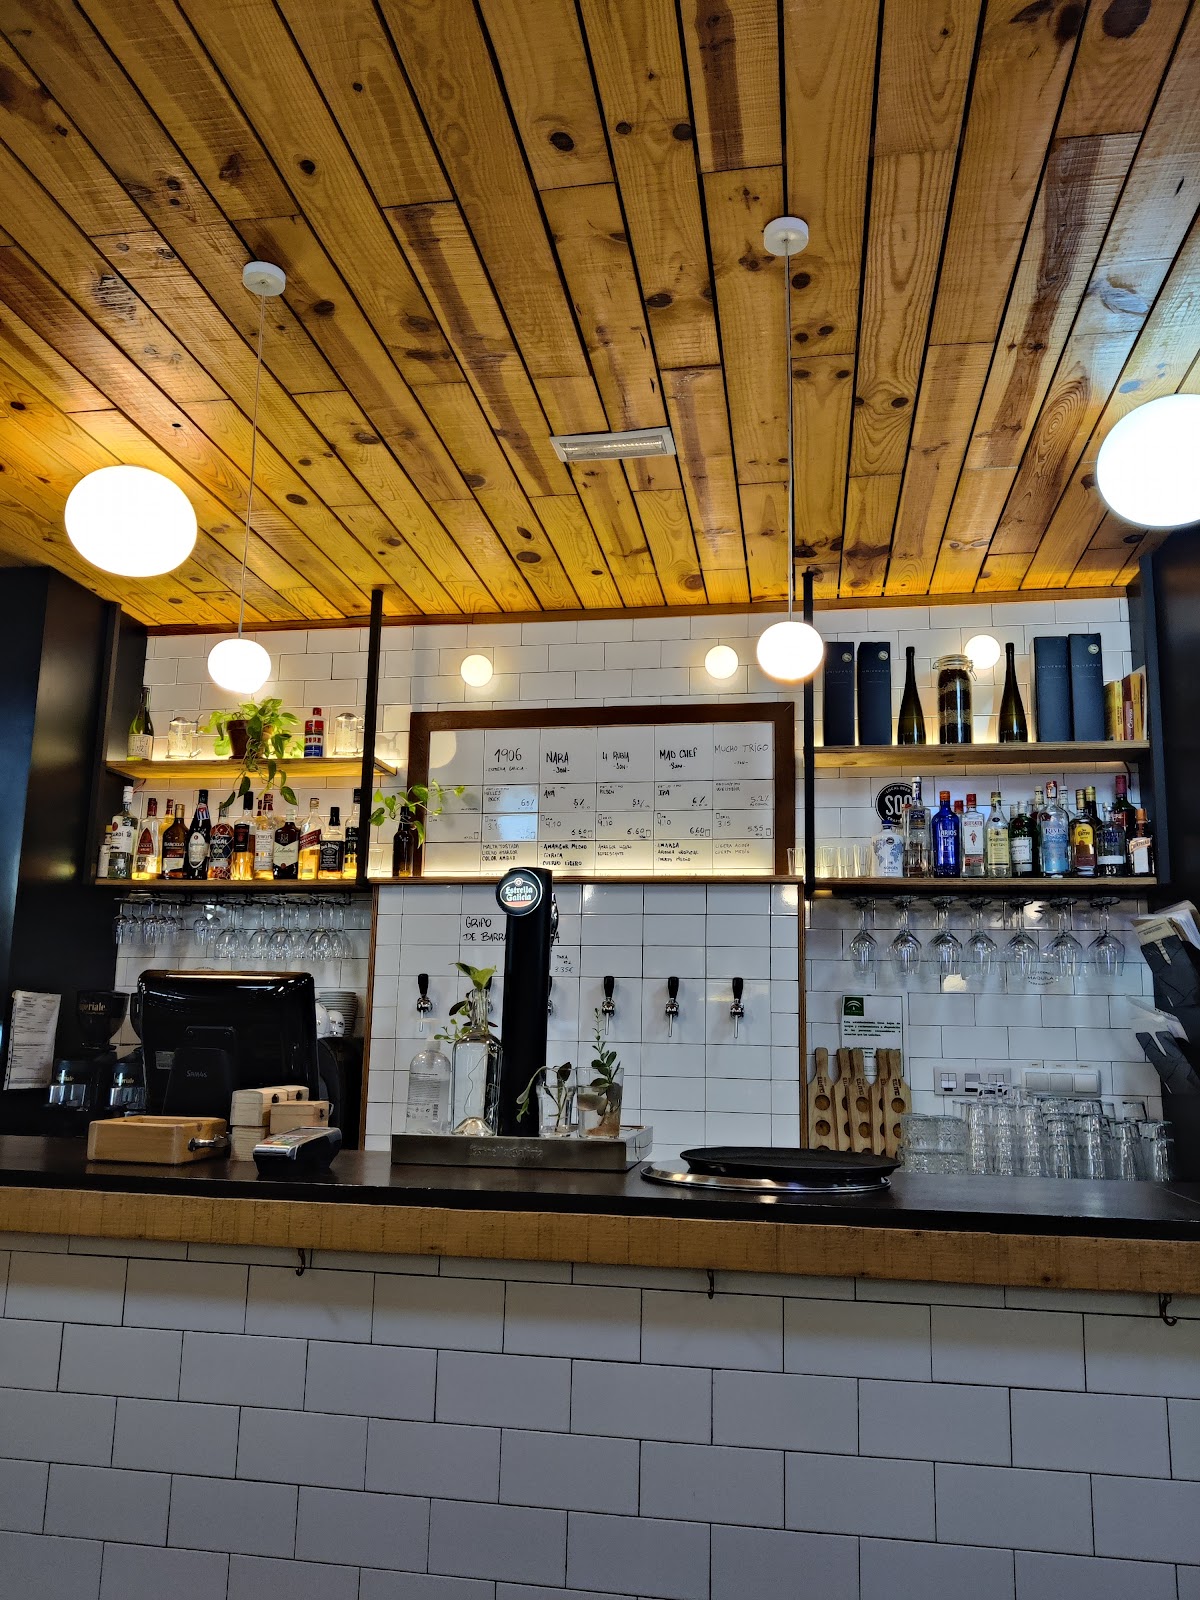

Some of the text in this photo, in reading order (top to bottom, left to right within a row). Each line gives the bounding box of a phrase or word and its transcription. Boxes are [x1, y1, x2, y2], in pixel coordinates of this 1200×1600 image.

[714, 744, 738, 753] MUCHO
[494, 748, 522, 762] 1906
[546, 750, 569, 764] NARA
[660, 749, 676, 761] MAD
[938, 829, 957, 837] LARIOS
[505, 886, 533, 895] Estrella
[506, 893, 532, 902] Galicia
[463, 932, 477, 941] DE
